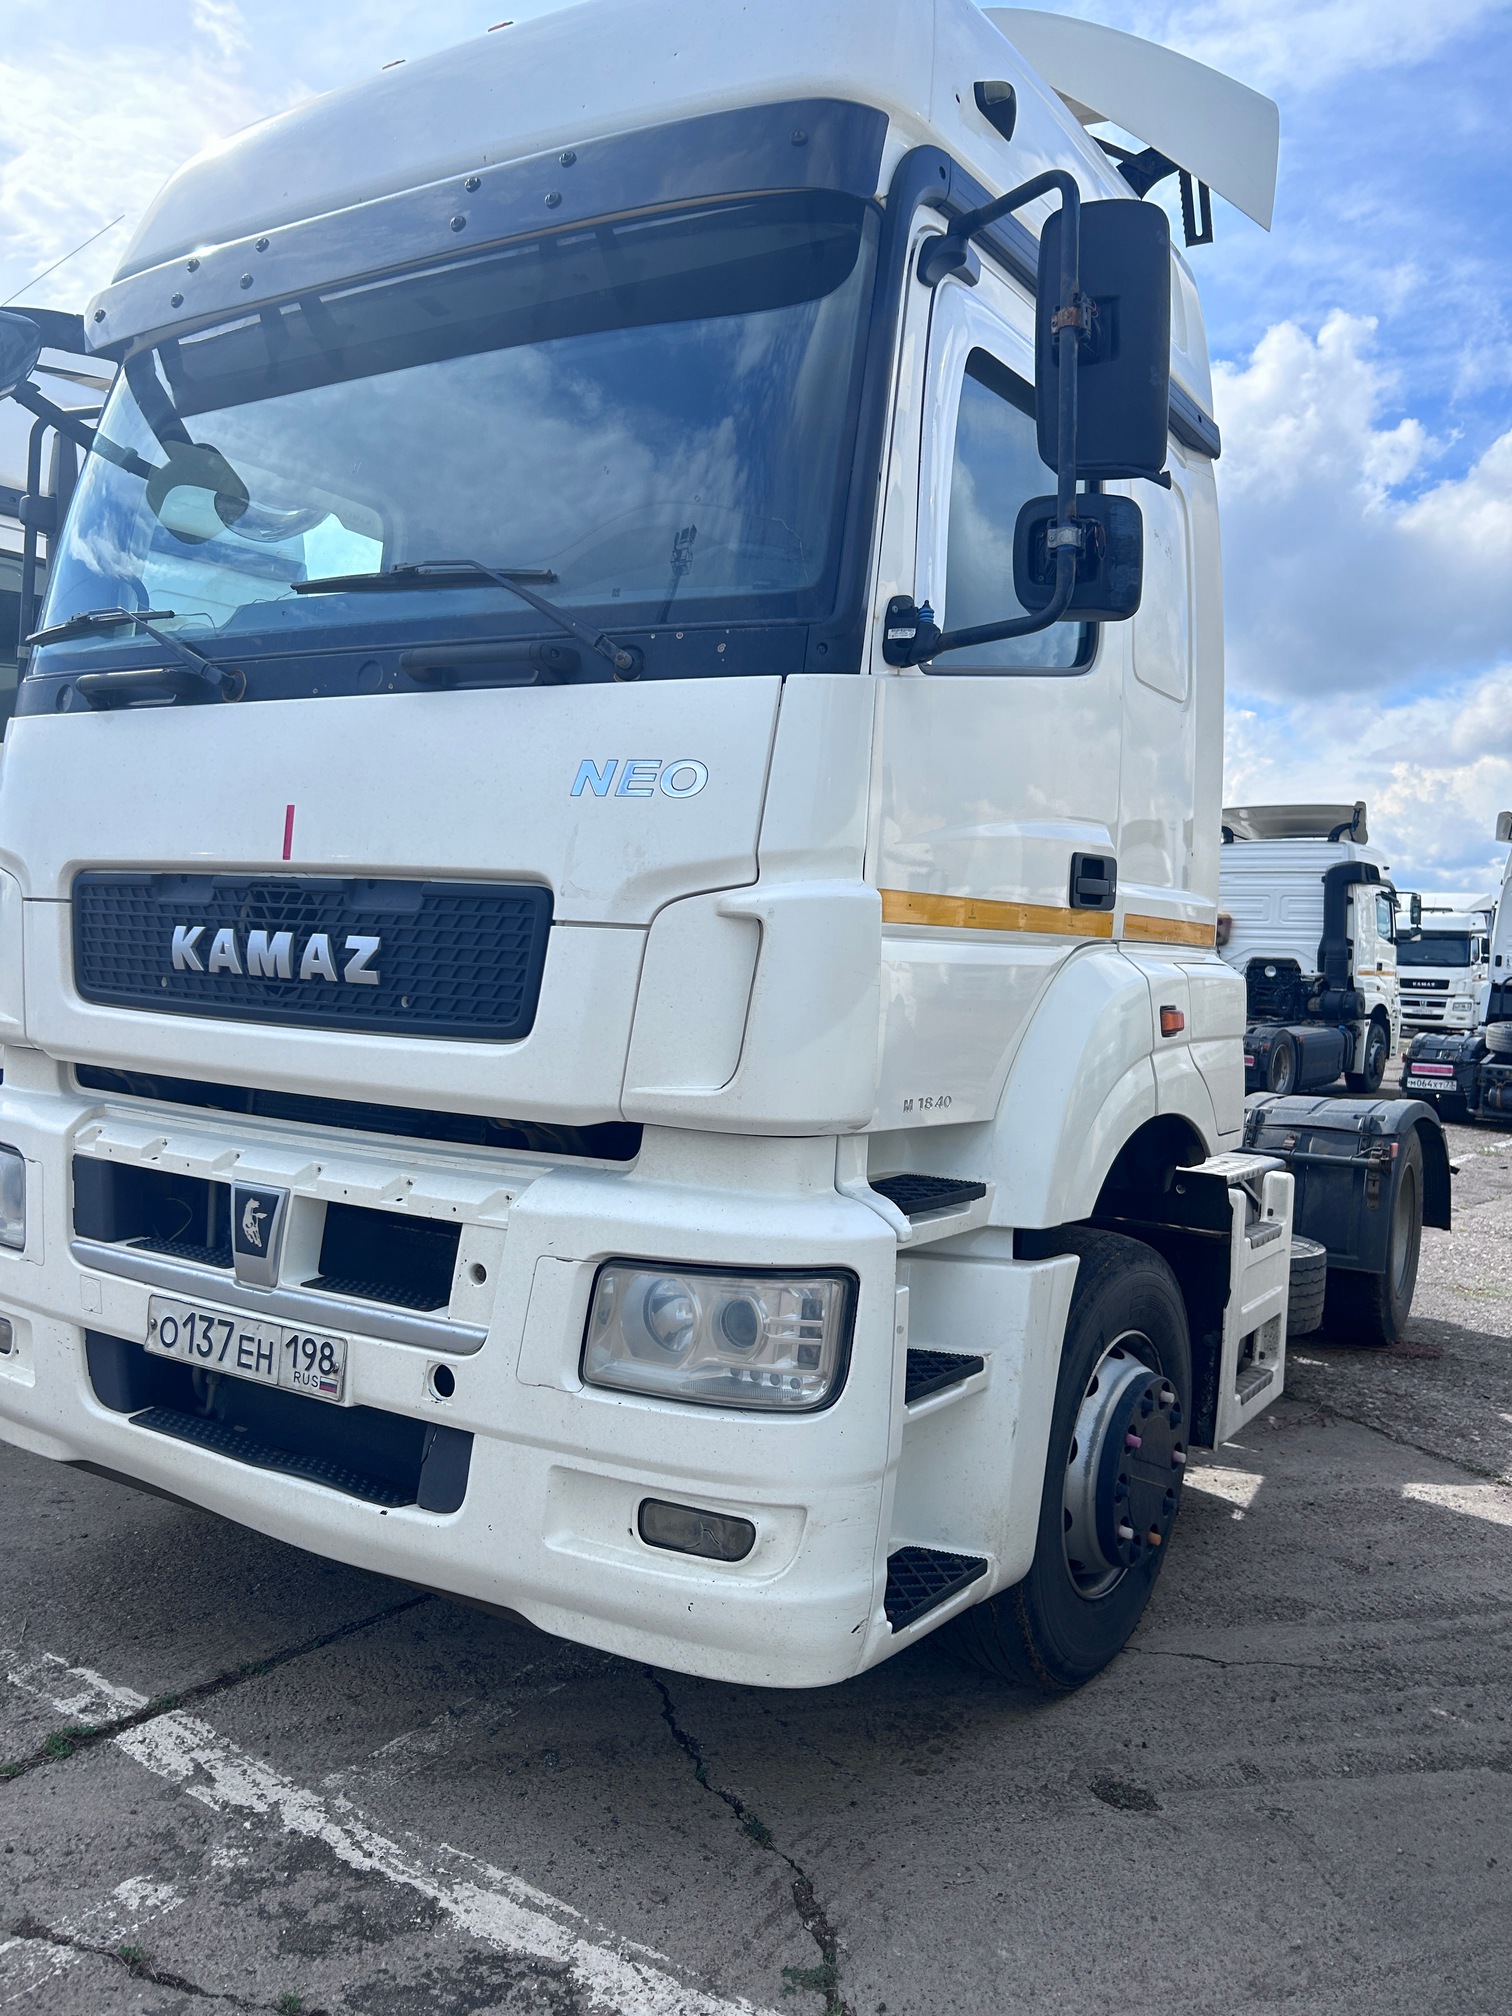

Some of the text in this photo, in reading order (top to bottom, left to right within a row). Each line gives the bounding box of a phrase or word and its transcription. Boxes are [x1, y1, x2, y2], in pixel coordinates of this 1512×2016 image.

[570, 758, 709, 799] NEO
[171, 925, 382, 985] KAMAZ
[903, 1095, 952, 1113] M 1840
[285, 1334, 335, 1376] 198
[293, 1371, 319, 1388] RUS
